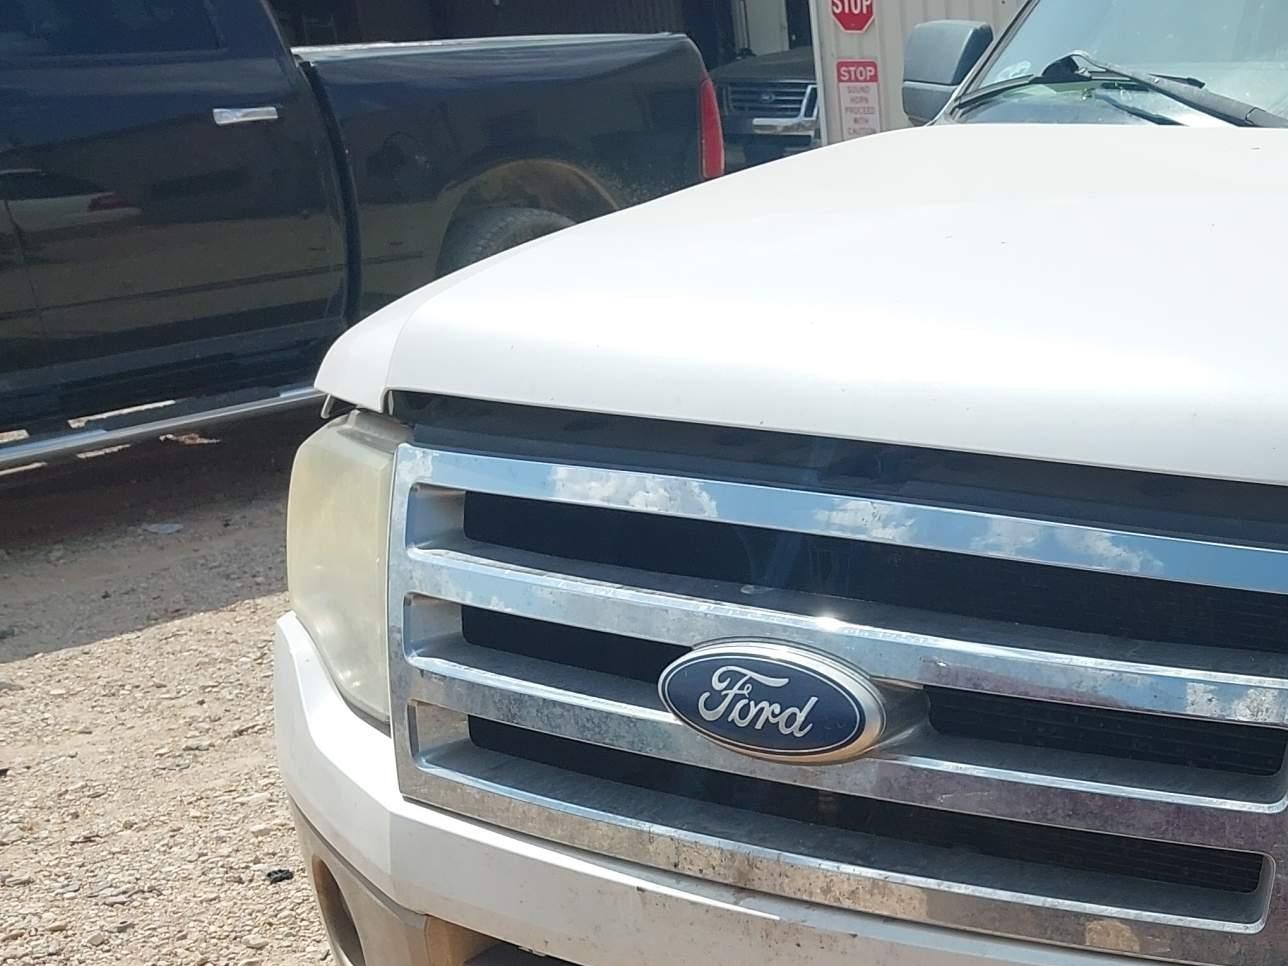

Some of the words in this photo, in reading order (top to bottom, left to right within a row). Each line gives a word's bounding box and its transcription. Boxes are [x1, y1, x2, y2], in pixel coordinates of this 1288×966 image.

[832, 0, 872, 14] STOP
[840, 67, 875, 81] STOP
[698, 665, 818, 737] Ford
